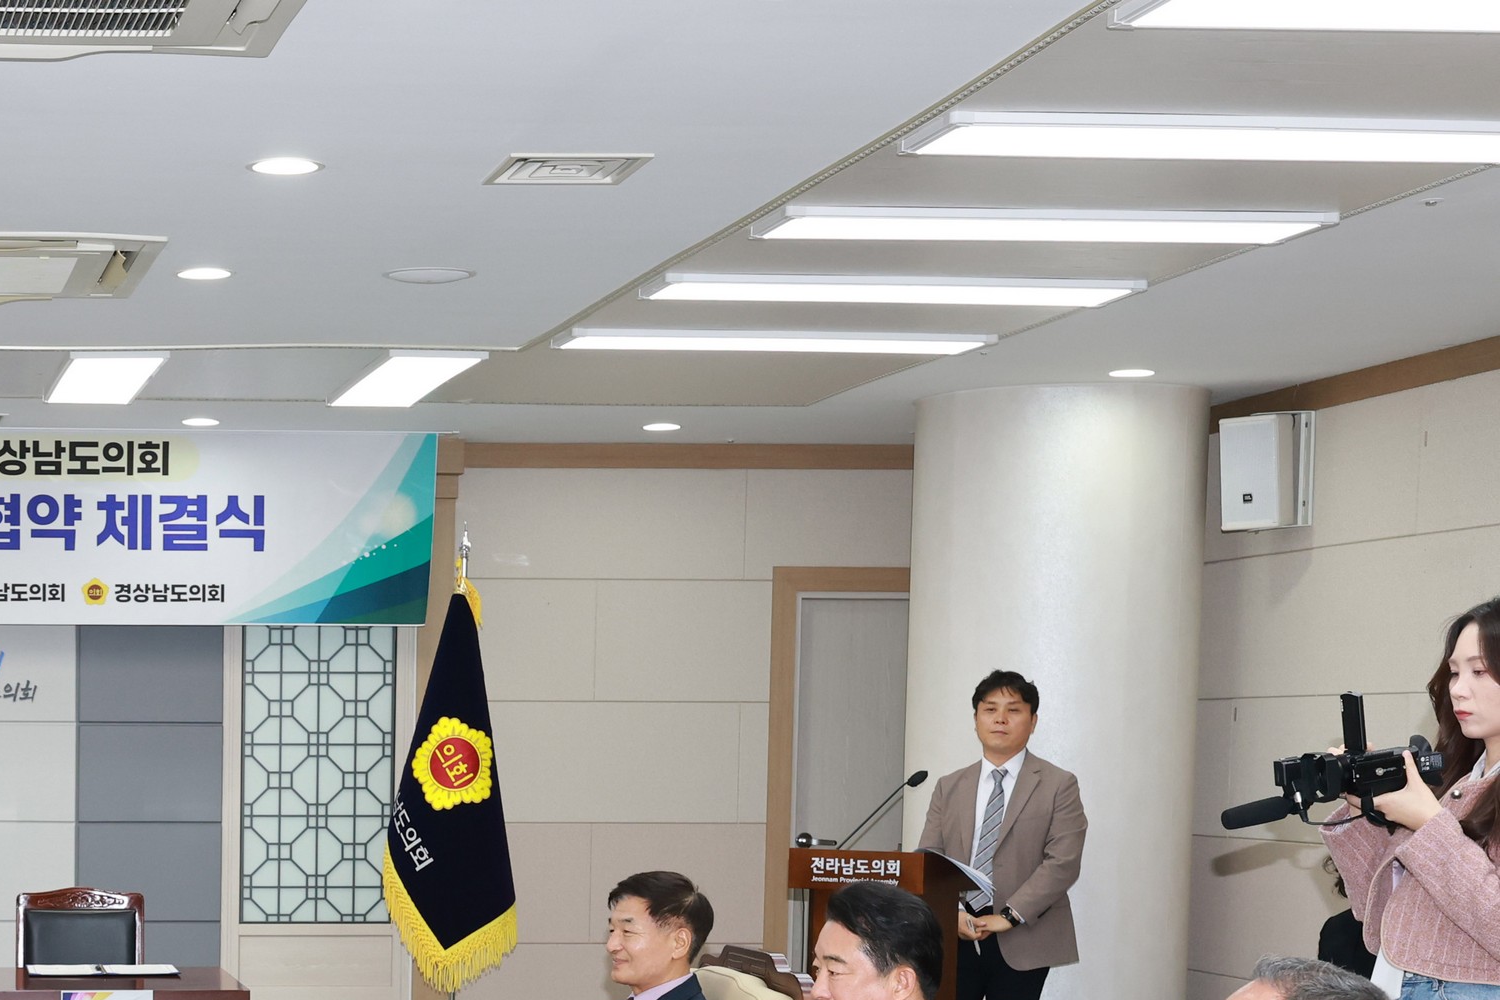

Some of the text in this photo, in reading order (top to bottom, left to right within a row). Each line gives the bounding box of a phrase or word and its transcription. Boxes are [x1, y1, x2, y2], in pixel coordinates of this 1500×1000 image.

[96, 494, 266, 552] 체결식
[114, 583, 226, 602] 경상남도의회
[435, 744, 474, 787] 의회
[810, 857, 901, 877] 전라남도의회
